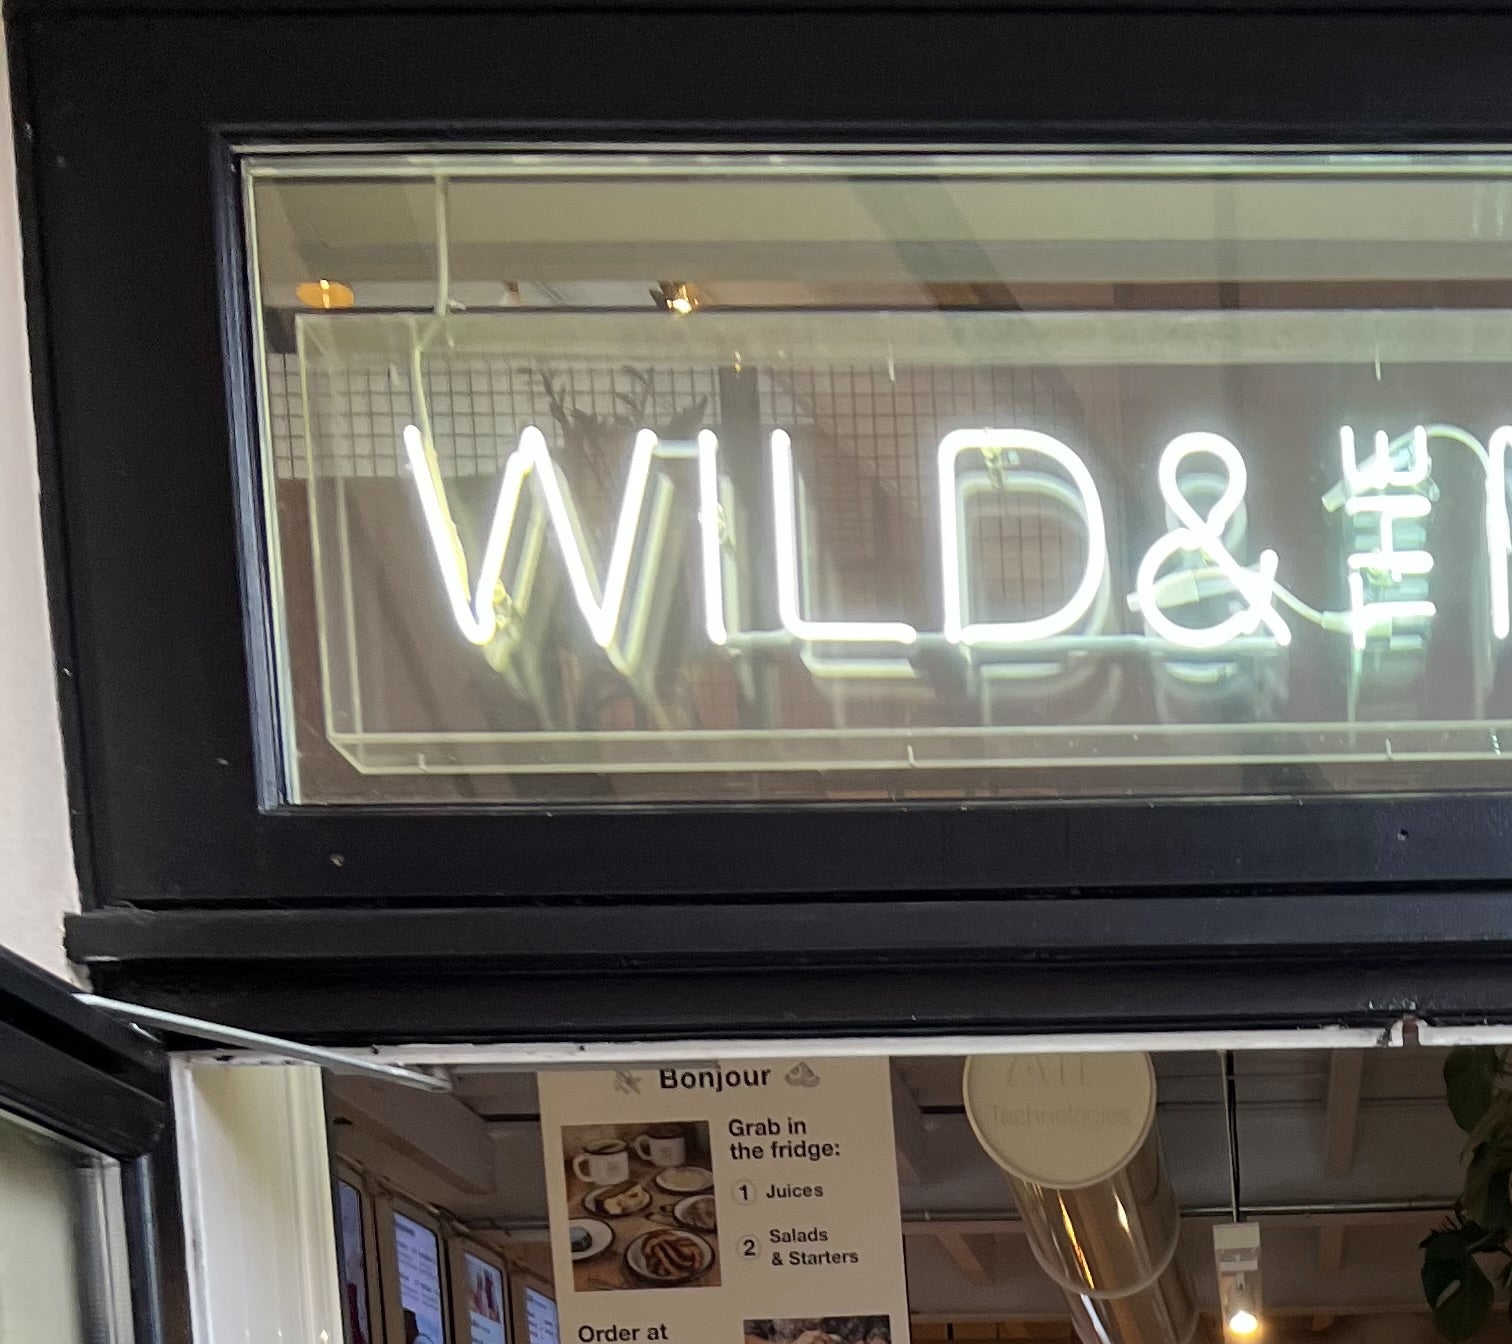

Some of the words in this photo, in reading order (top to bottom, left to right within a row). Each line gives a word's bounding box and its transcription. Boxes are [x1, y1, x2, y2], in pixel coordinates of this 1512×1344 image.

[402, 426, 1110, 646] WILD
[660, 1067, 771, 1091] Bonjour
[729, 1119, 781, 1137] Grab
[787, 1117, 807, 1134] in
[730, 1142, 763, 1160] the
[770, 1140, 841, 1162] fridge:
[739, 1185, 749, 1200] 1
[766, 1183, 823, 1199] Juices
[769, 1228, 828, 1244] Salads
[743, 1240, 756, 1256] 2
[771, 1252, 784, 1266] &
[788, 1250, 859, 1266] Starters
[578, 1325, 641, 1344] Order
[647, 1324, 668, 1341] at
